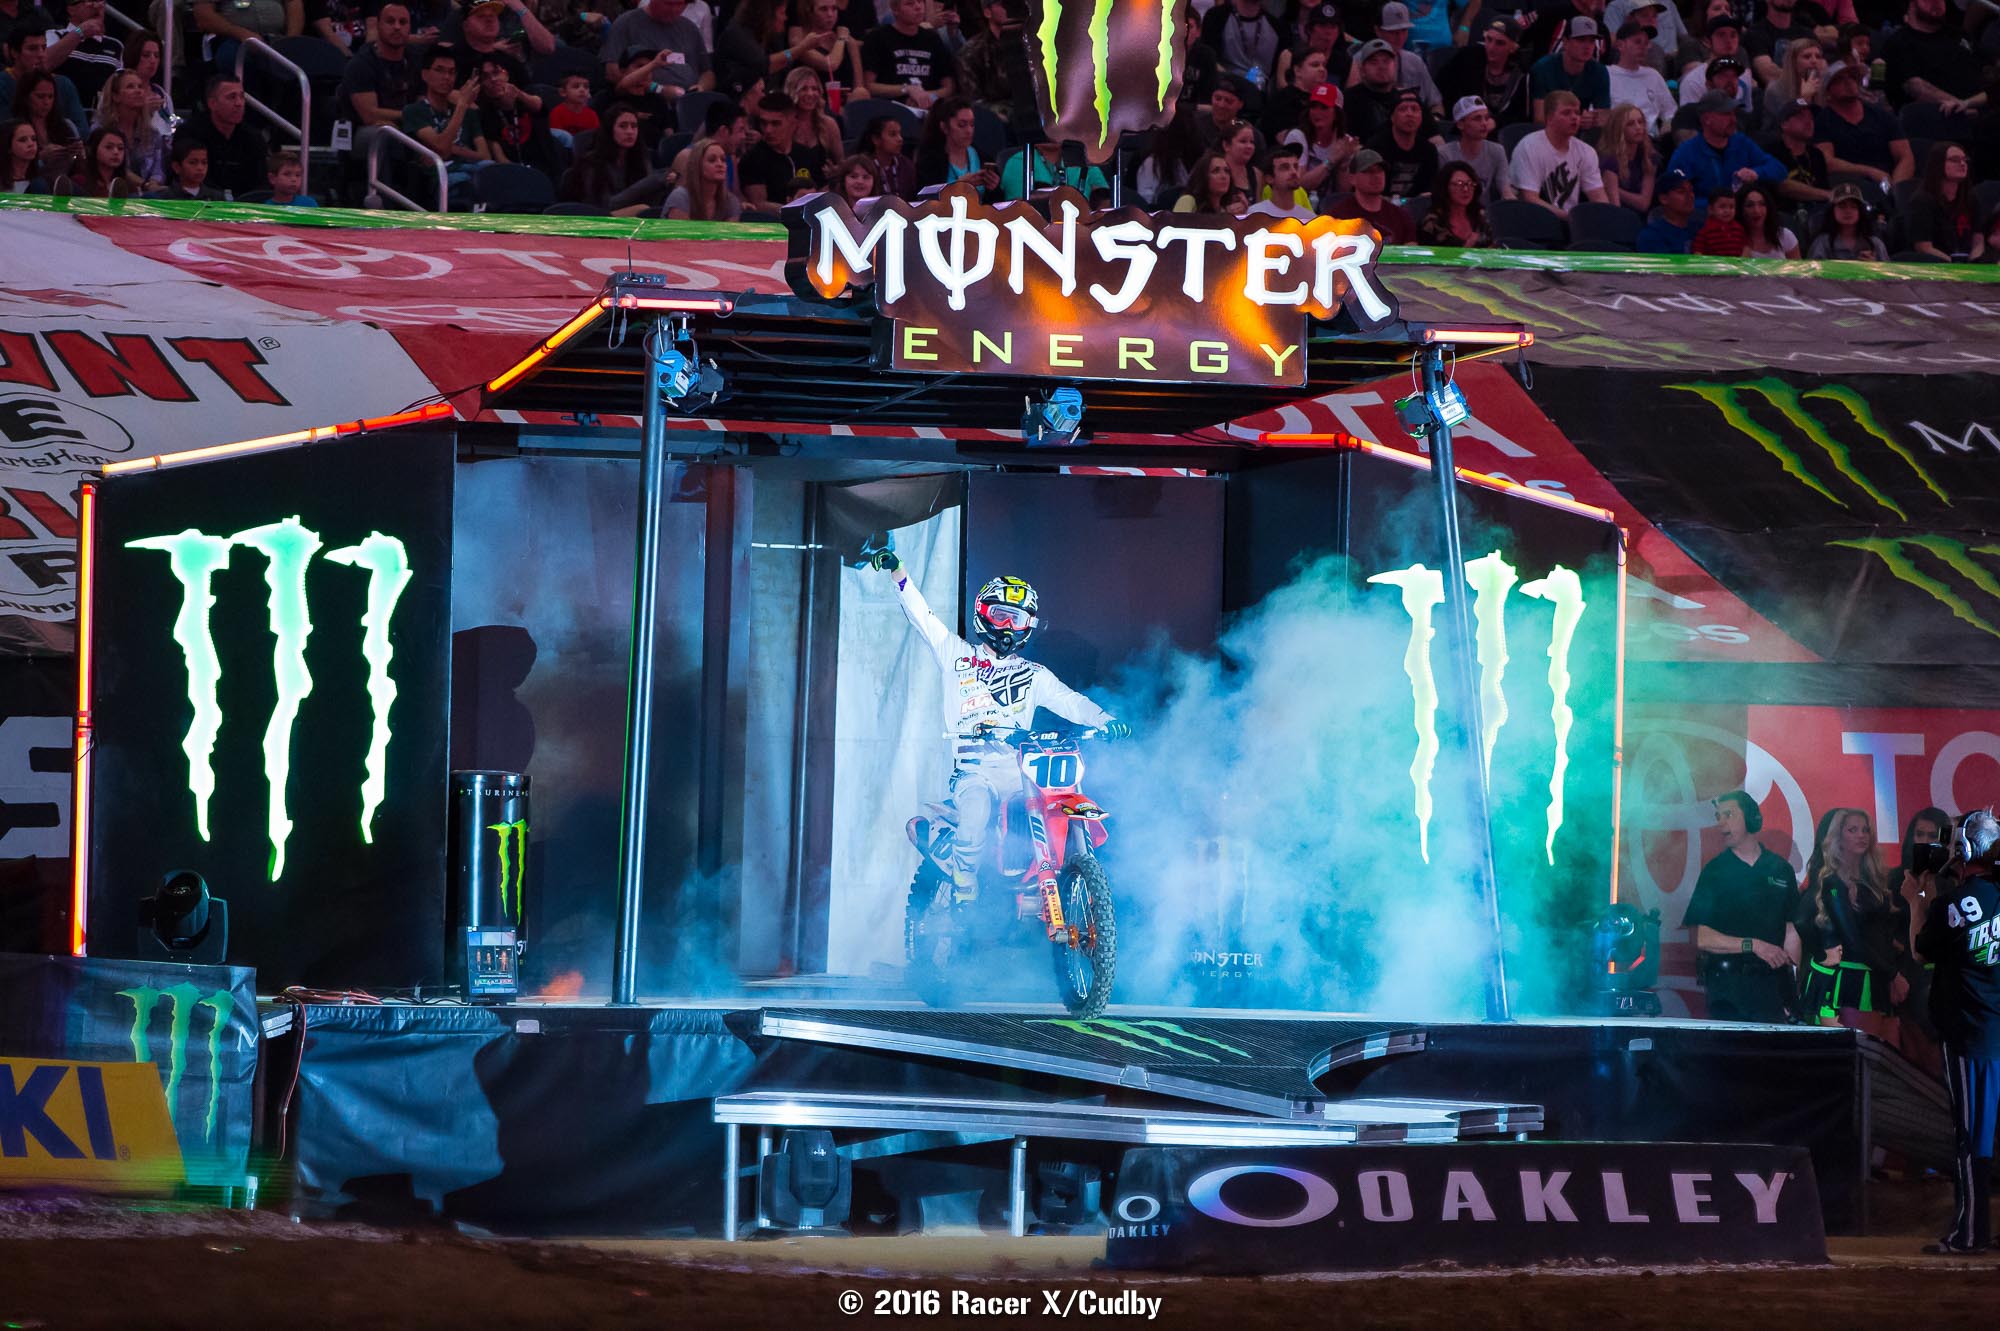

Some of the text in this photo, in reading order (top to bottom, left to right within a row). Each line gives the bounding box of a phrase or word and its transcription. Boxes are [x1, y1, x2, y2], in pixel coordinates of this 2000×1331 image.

[814, 196, 1392, 322] MONSTER
[903, 327, 1300, 378] ENERGY
[1028, 755, 1078, 788] 10
[466, 788, 521, 797] TURINE
[1191, 949, 1263, 968] ONSTER
[1358, 1170, 1788, 1224] OAKLEY
[1108, 1224, 1171, 1239] OAKLEY
